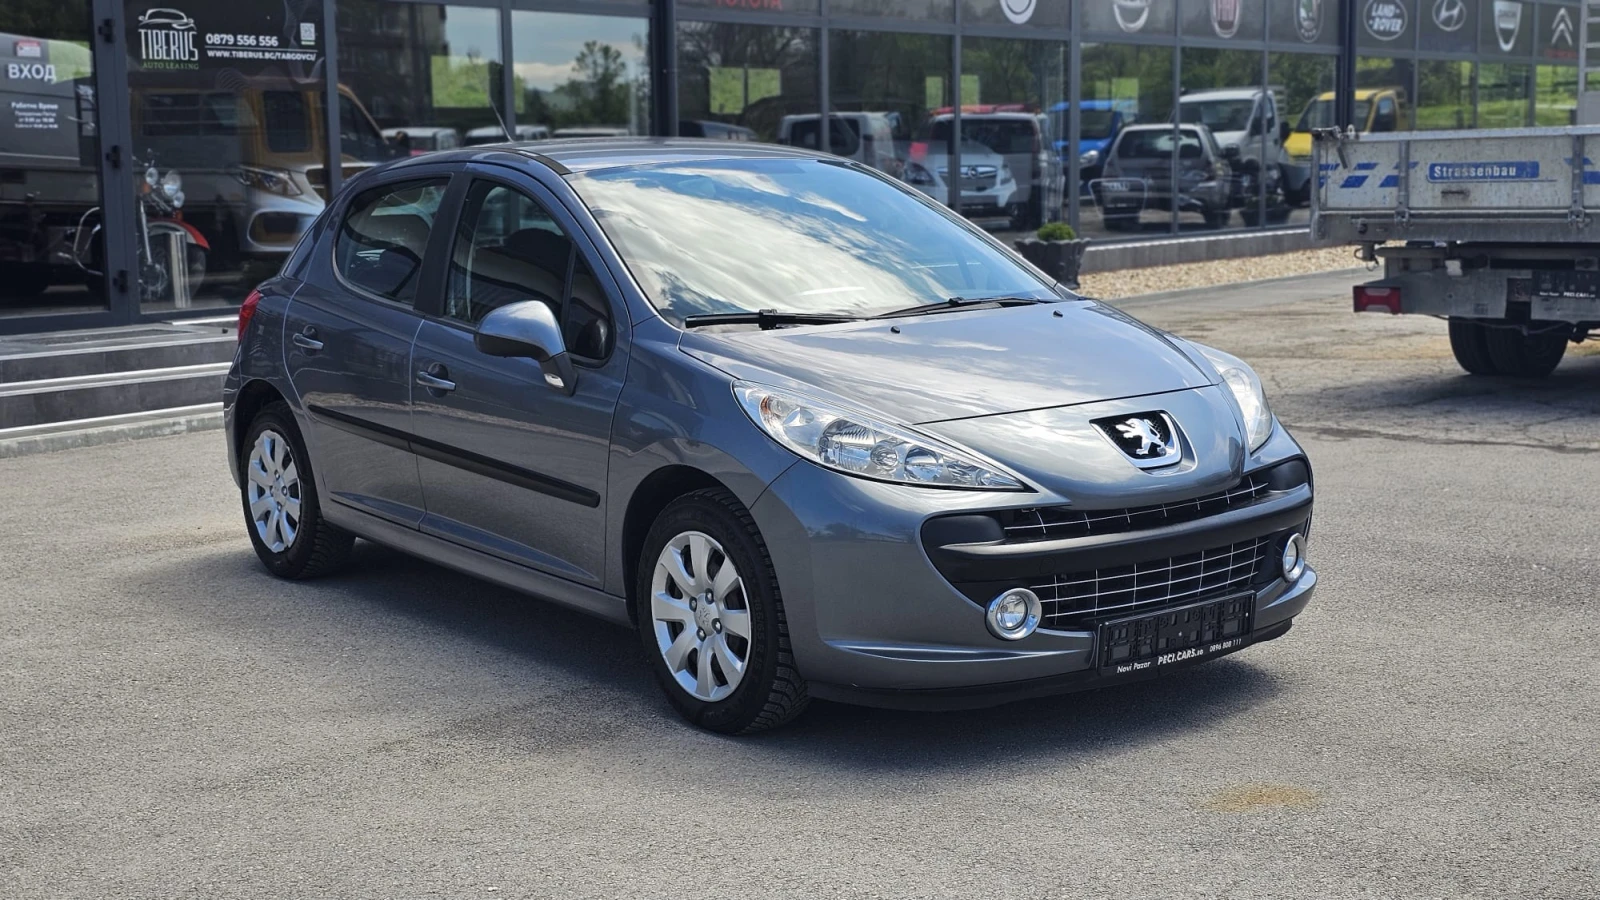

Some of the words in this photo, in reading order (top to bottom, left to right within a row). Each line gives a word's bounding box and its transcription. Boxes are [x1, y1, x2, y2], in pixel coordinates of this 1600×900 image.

[1371, 2, 1396, 17] LAND
[1373, 17, 1402, 31] ROVER
[138, 29, 199, 61] TIBERUS
[205, 33, 235, 45] 0879
[236, 35, 257, 47] 556
[258, 36, 279, 48] 556
[8, 63, 57, 82] ВХОД
[143, 61, 164, 69] AUTO
[165, 62, 199, 70] LEASING
[1434, 165, 1517, 178] Strassenbau
[1117, 663, 1133, 673] Novi
[1133, 662, 1151, 670] Pazar
